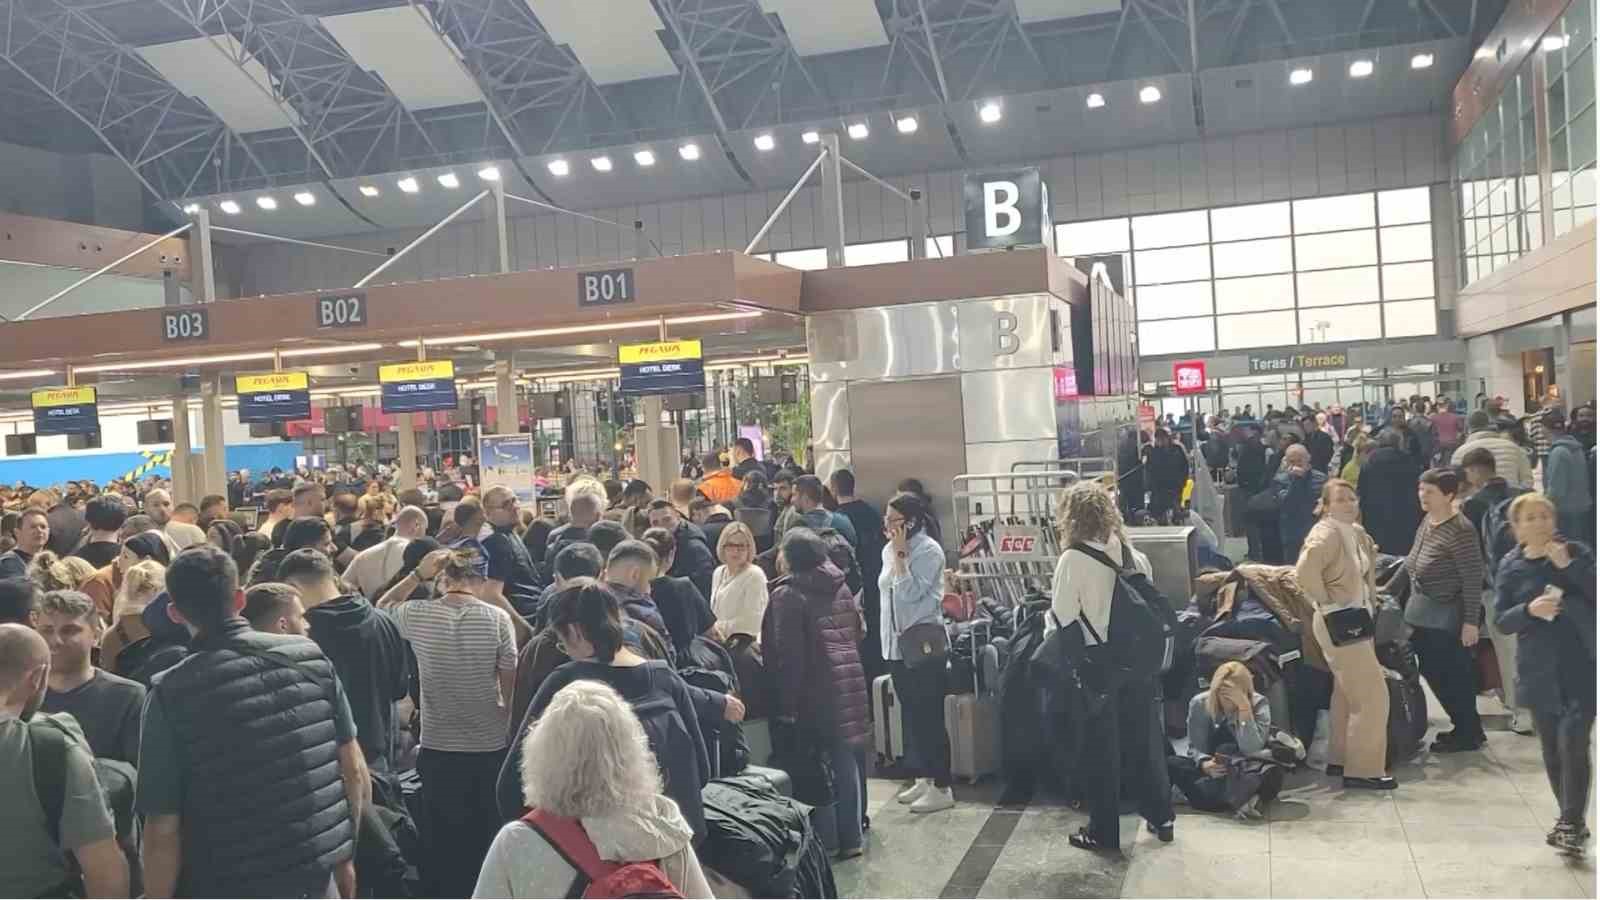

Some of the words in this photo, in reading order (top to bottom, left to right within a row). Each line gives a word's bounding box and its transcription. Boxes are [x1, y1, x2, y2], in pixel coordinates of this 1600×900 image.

[983, 181, 1022, 237] B
[585, 273, 627, 301] B01
[320, 298, 361, 325] B02
[166, 313, 203, 338] B03
[992, 311, 1020, 355] B
[1251, 358, 1287, 370] Teras
[1289, 356, 1295, 368] /
[1297, 355, 1345, 367] Terrace
